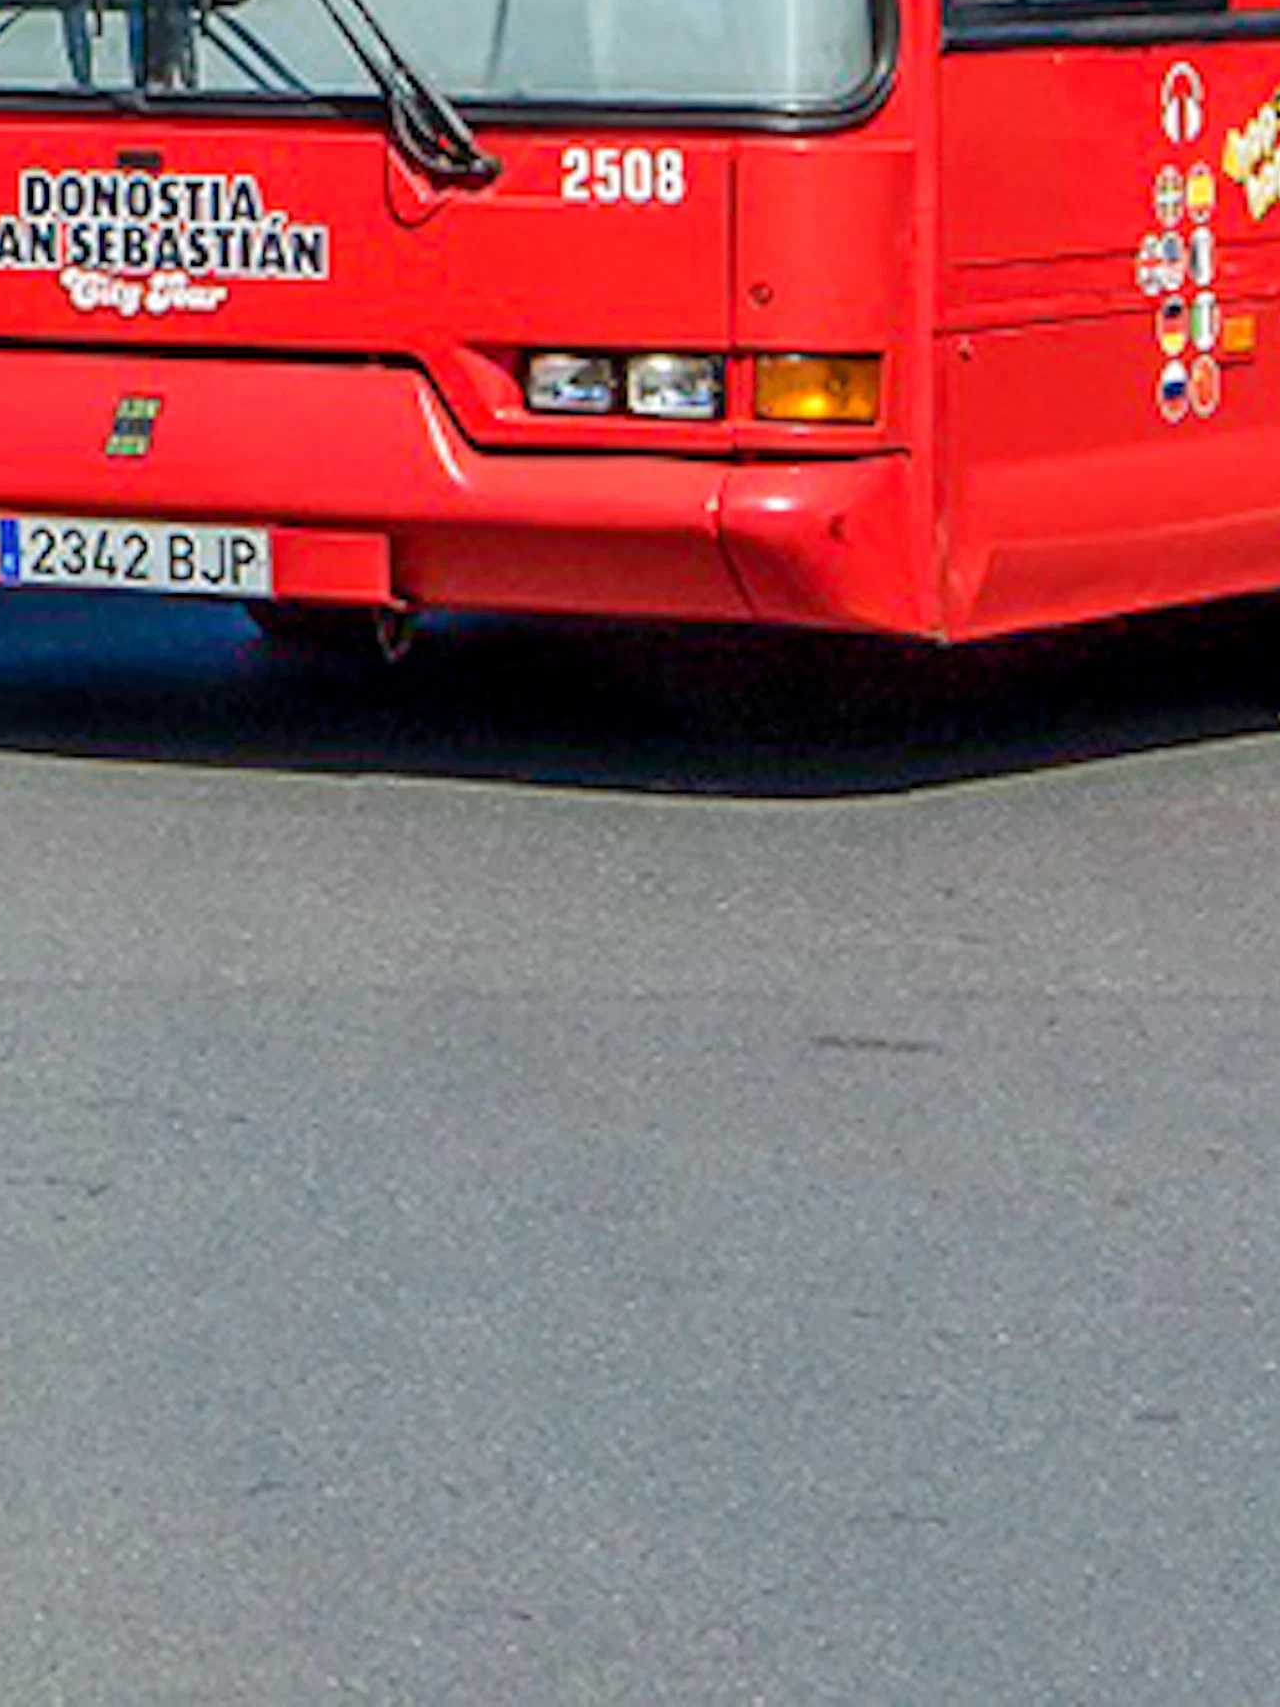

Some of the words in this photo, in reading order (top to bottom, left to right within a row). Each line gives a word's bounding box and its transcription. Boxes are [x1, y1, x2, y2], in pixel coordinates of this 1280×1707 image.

[23, 172, 262, 224] DONOSTIA
[560, 147, 685, 204] 2508
[70, 211, 326, 274] SEBASTIÁN
[30, 528, 150, 581] 2342
[168, 534, 257, 585] BJP
